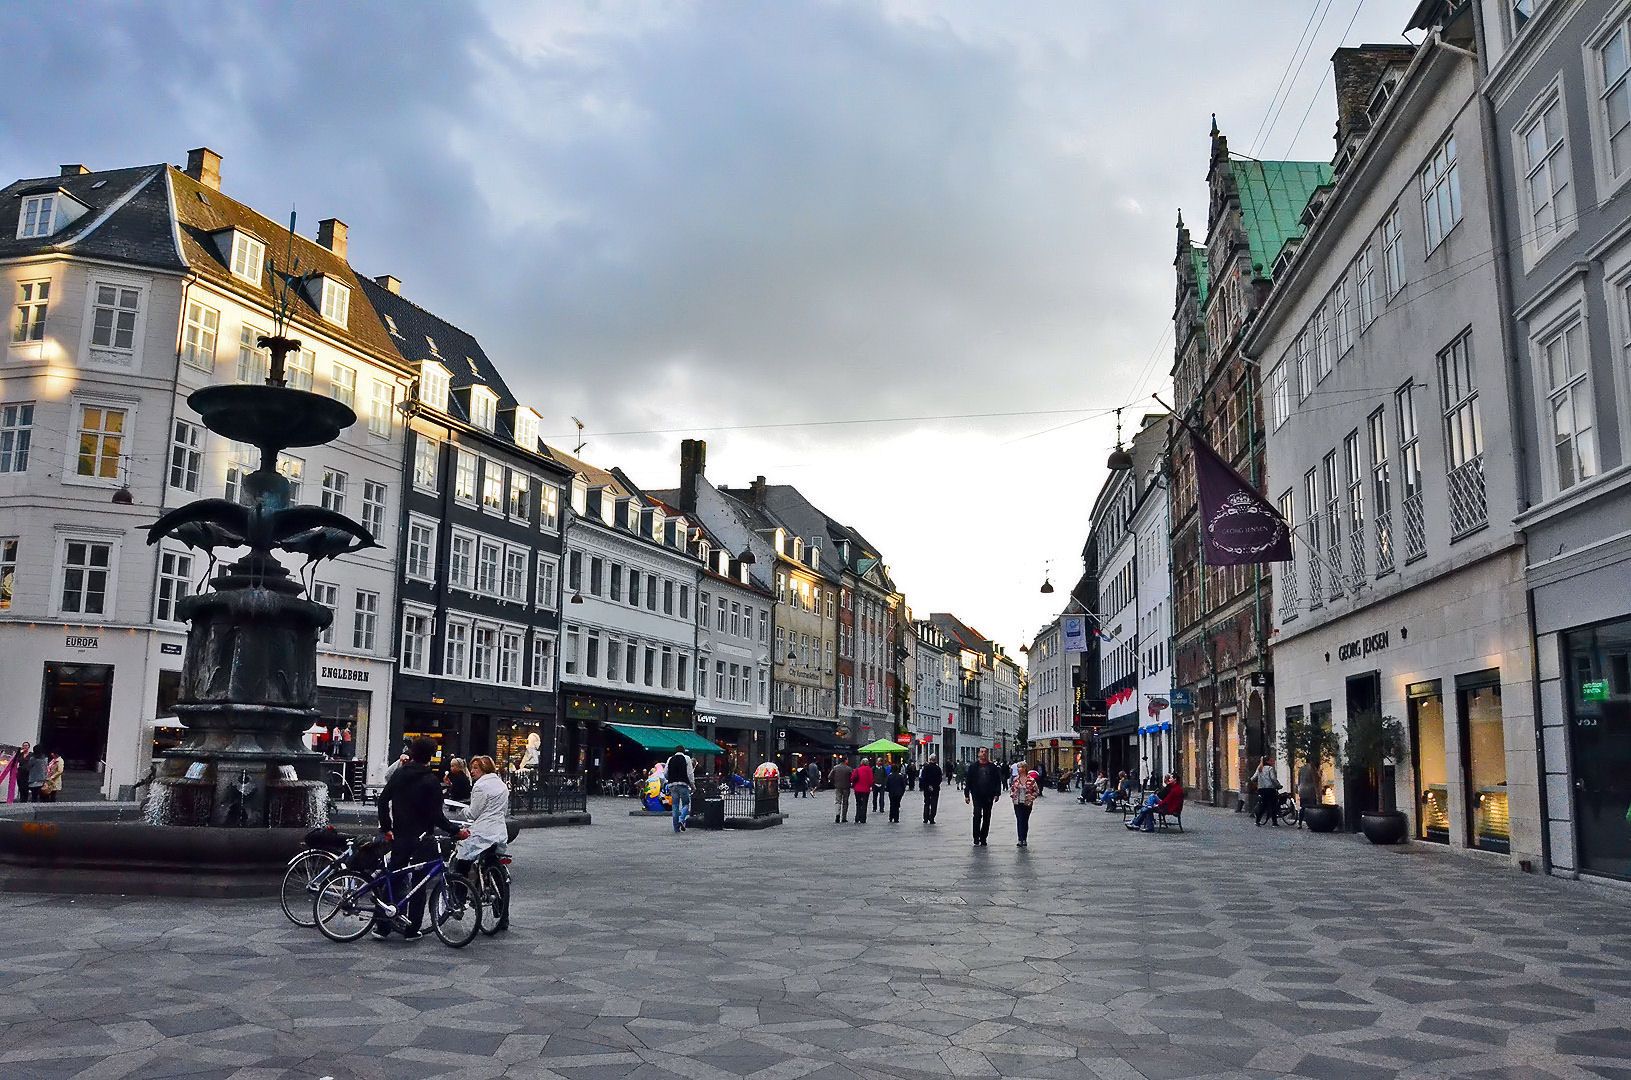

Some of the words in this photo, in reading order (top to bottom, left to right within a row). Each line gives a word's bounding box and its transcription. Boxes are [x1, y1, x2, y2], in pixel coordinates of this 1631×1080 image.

[66, 637, 98, 647] EUROPA
[1338, 640, 1361, 661] GEORG
[1363, 630, 1389, 659] JENSEN
